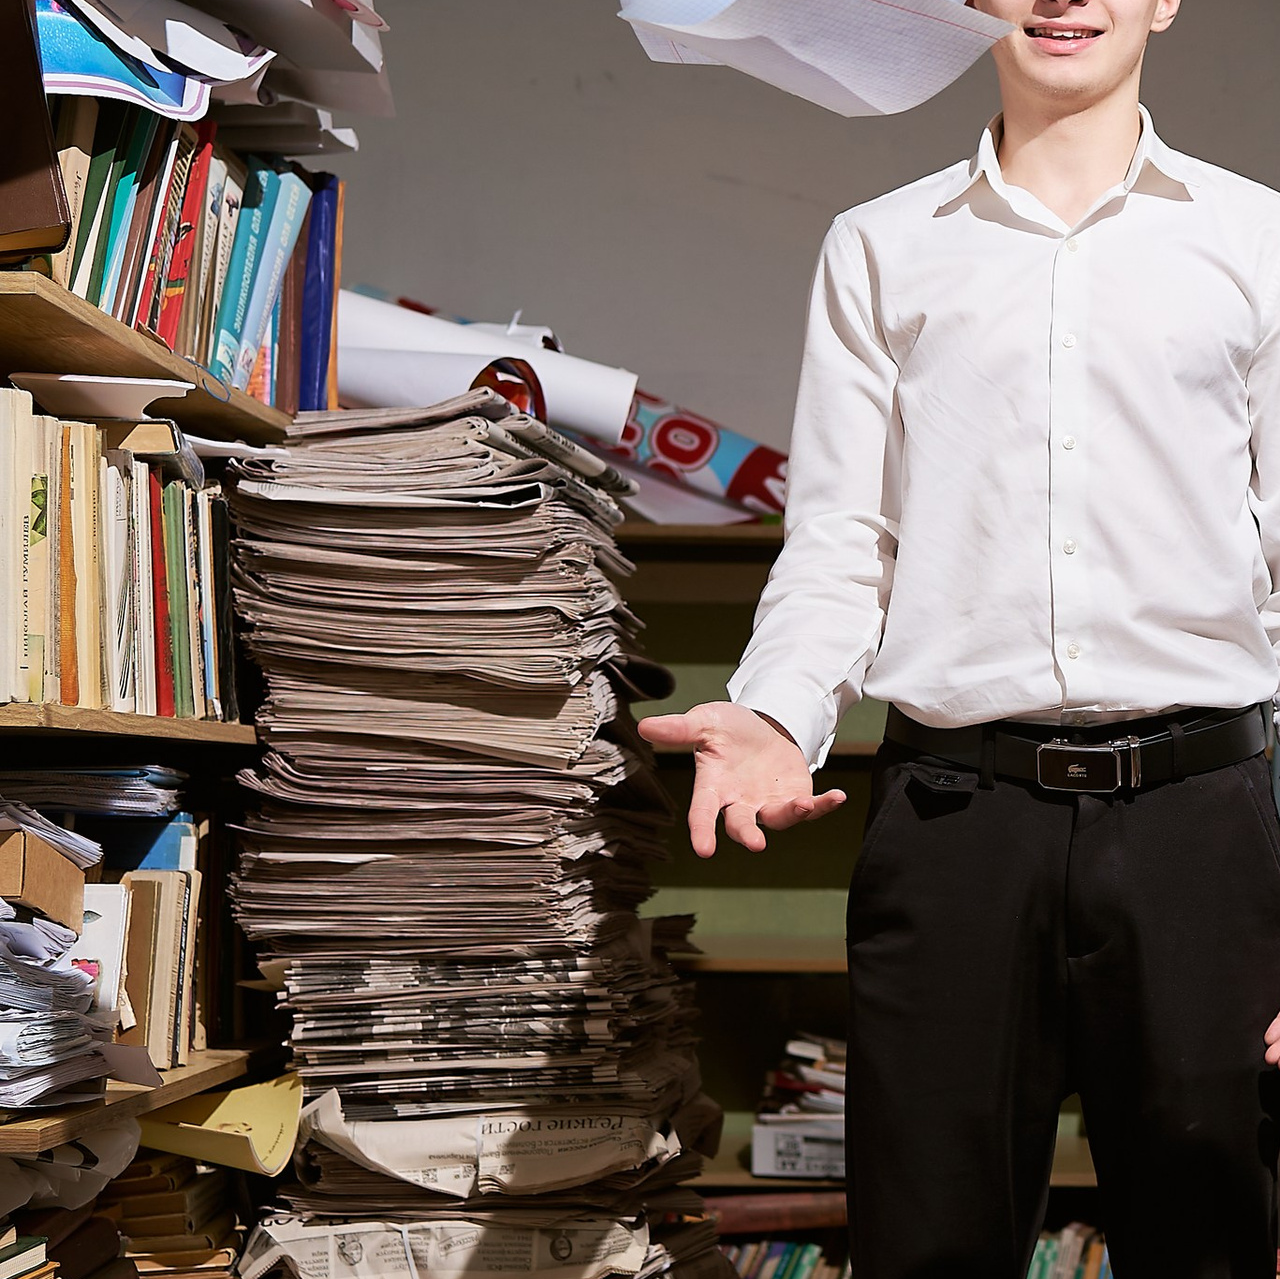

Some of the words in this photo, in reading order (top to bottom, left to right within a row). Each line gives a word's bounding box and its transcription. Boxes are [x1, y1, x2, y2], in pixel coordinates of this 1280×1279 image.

[235, 234, 260, 334] ЭНЦИКЛОПЕДИЯ
[250, 209, 262, 234] ДЛЯ
[256, 249, 285, 337] ЭНЦИКЛОПЕДИЯ
[280, 222, 292, 248] ДЛЯ
[286, 183, 301, 221] ДЕТЕЙ
[21, 515, 30, 583] ГУМИЛЕВ
[21, 588, 29, 658] НИКОЛАЙ
